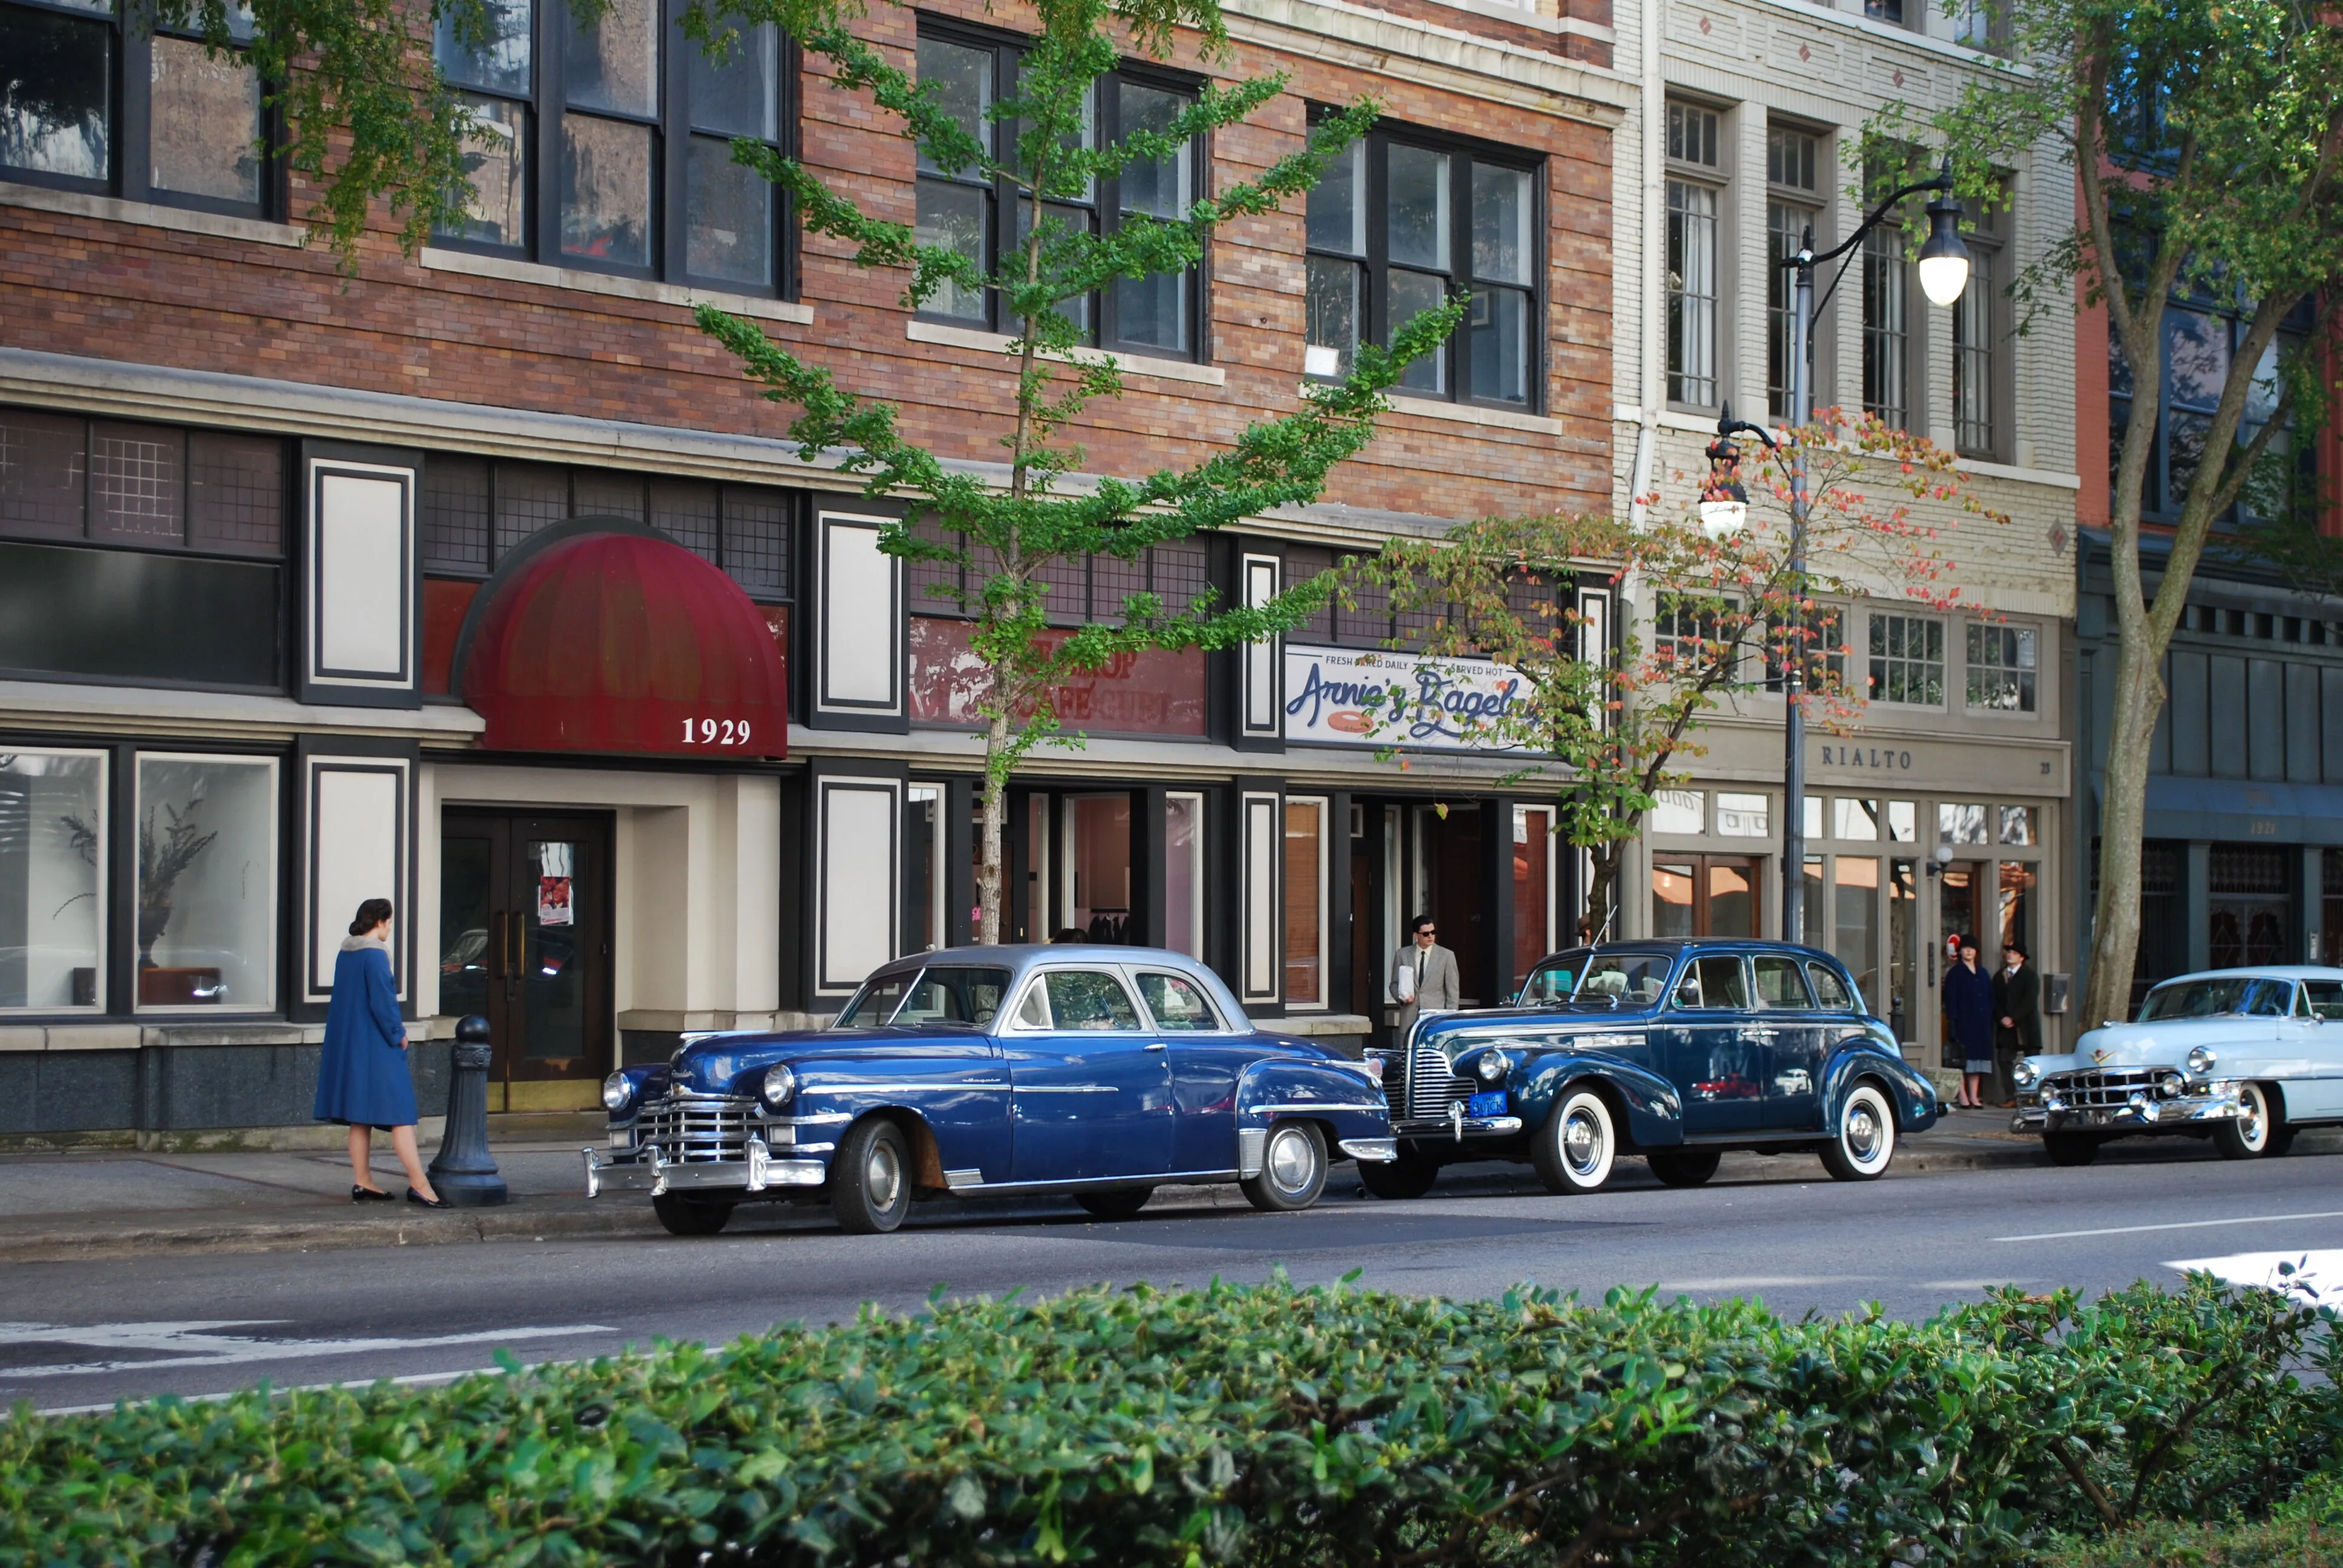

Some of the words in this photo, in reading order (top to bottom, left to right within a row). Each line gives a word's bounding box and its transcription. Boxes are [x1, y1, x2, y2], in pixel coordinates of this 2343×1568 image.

[1326, 655, 1353, 665] FRESH
[1385, 660, 1409, 670] DAILY
[1486, 667, 1504, 676] HOT
[1286, 662, 1409, 727] Arnie's
[681, 717, 751, 745] 1929
[1822, 746, 1912, 769] RIALTO
[1472, 1100, 1504, 1114] BUICK
